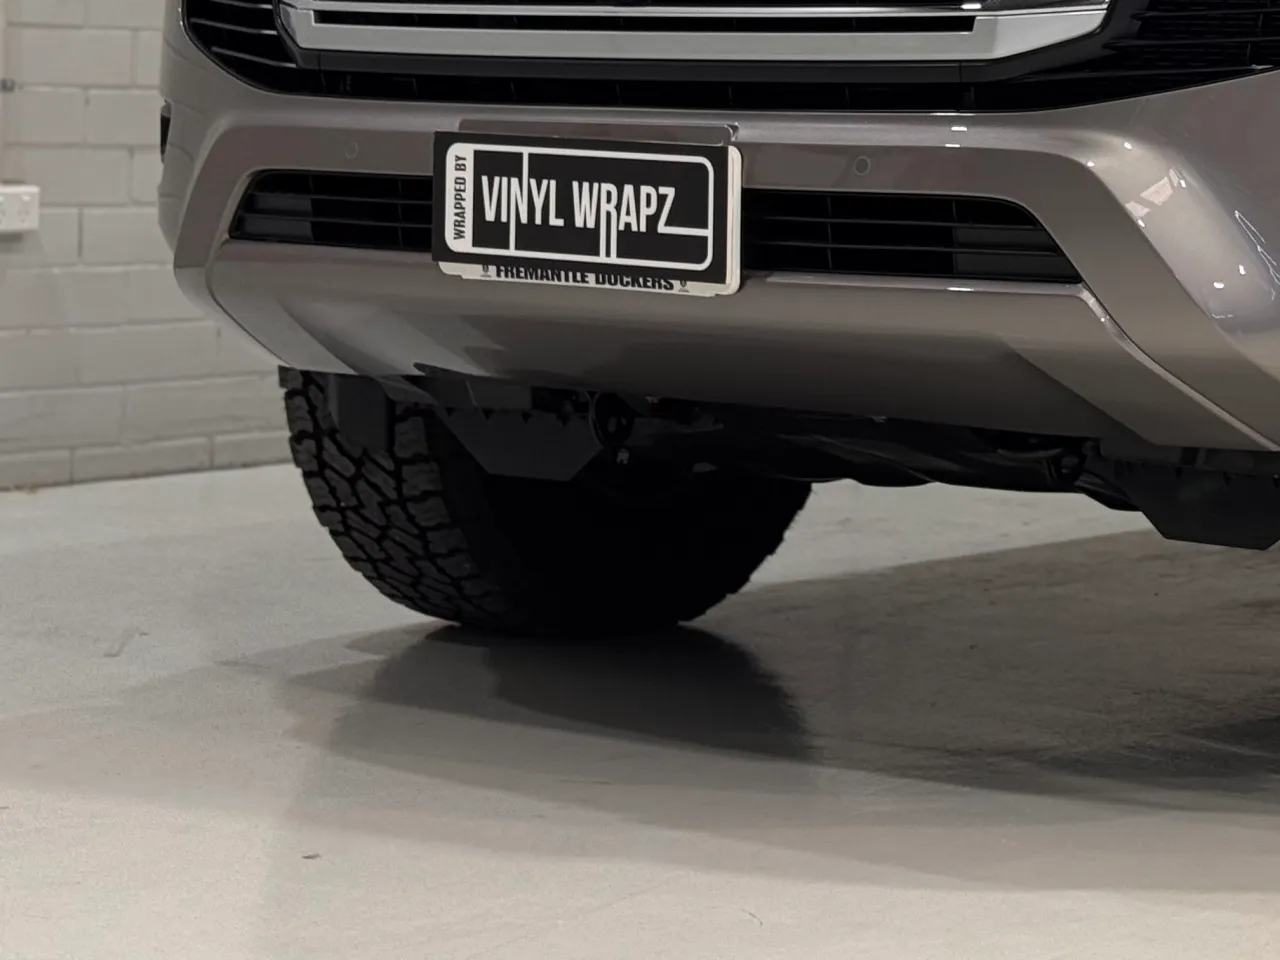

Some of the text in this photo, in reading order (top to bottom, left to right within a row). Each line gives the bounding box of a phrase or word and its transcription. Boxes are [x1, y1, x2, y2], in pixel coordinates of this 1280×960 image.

[452, 154, 468, 240] WRAPPED BY
[481, 173, 679, 240] VINYL WRAPZ
[495, 265, 589, 284] FREMANTLE
